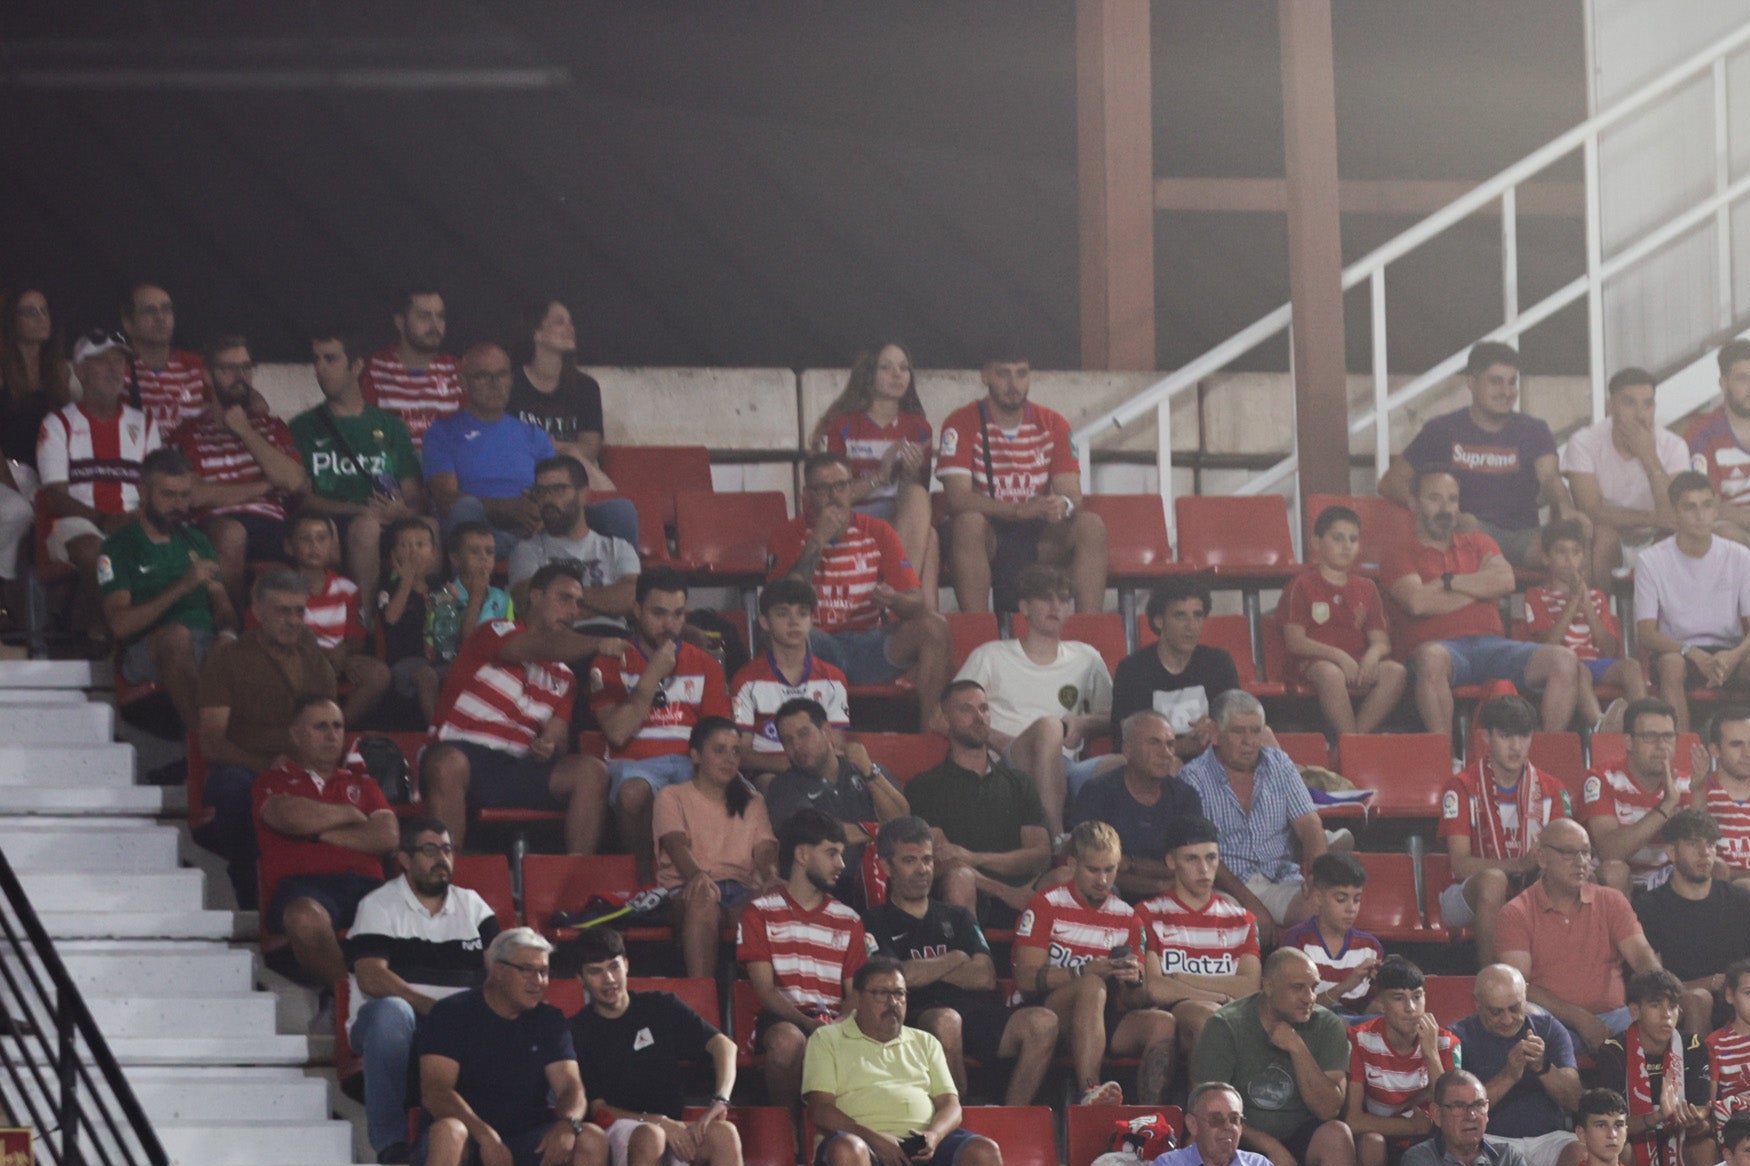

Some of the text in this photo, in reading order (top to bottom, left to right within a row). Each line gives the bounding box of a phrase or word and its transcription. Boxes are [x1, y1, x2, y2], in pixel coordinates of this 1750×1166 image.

[312, 450, 388, 477] Platzi
[1453, 444, 1517, 470] Supreme
[1164, 949, 1233, 975] Platzi
